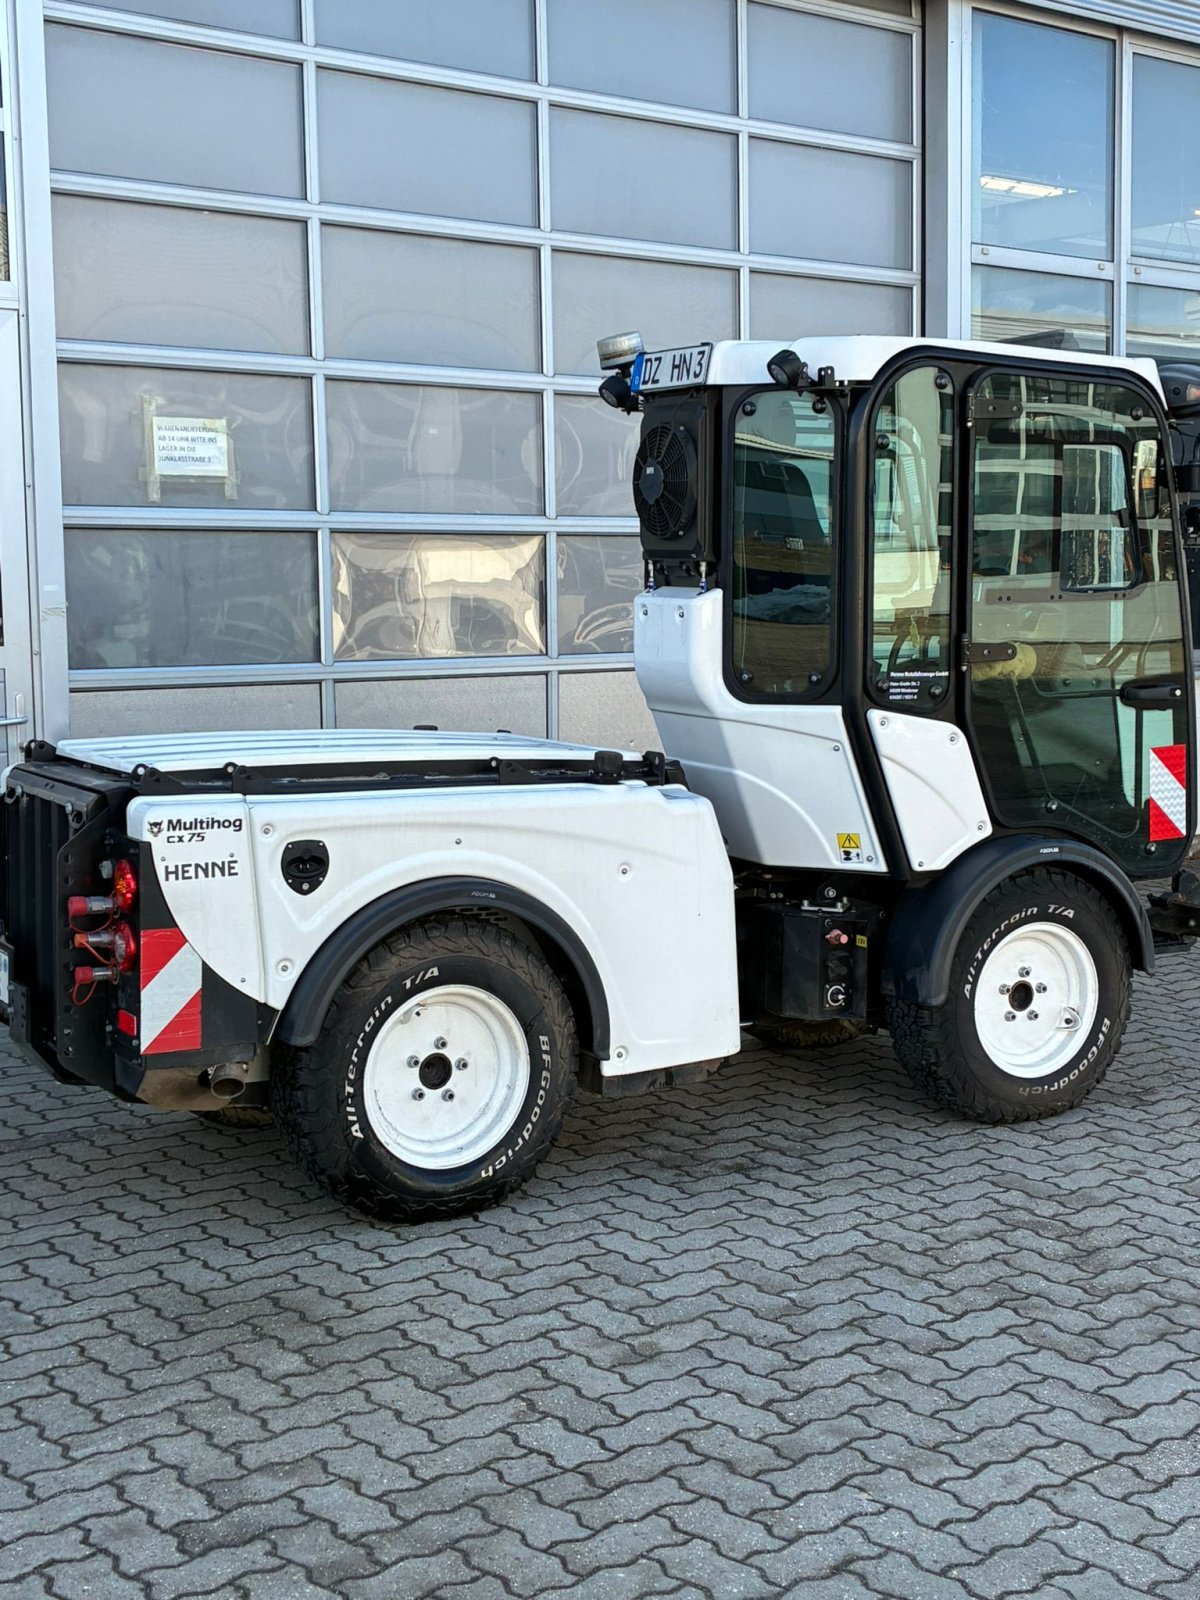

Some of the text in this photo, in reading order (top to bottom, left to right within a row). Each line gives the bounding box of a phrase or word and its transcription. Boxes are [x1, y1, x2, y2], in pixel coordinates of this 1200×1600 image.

[642, 350, 706, 385] DZ HN 3
[166, 817, 243, 832] Multihog
[164, 860, 239, 881] HENNE
[964, 904, 1076, 1000] All-Terrain T/A
[344, 966, 440, 1140] All-Terrain T/A
[1019, 1017, 1111, 1096] BFGoodrich
[480, 1034, 551, 1179] BFGoodrich
